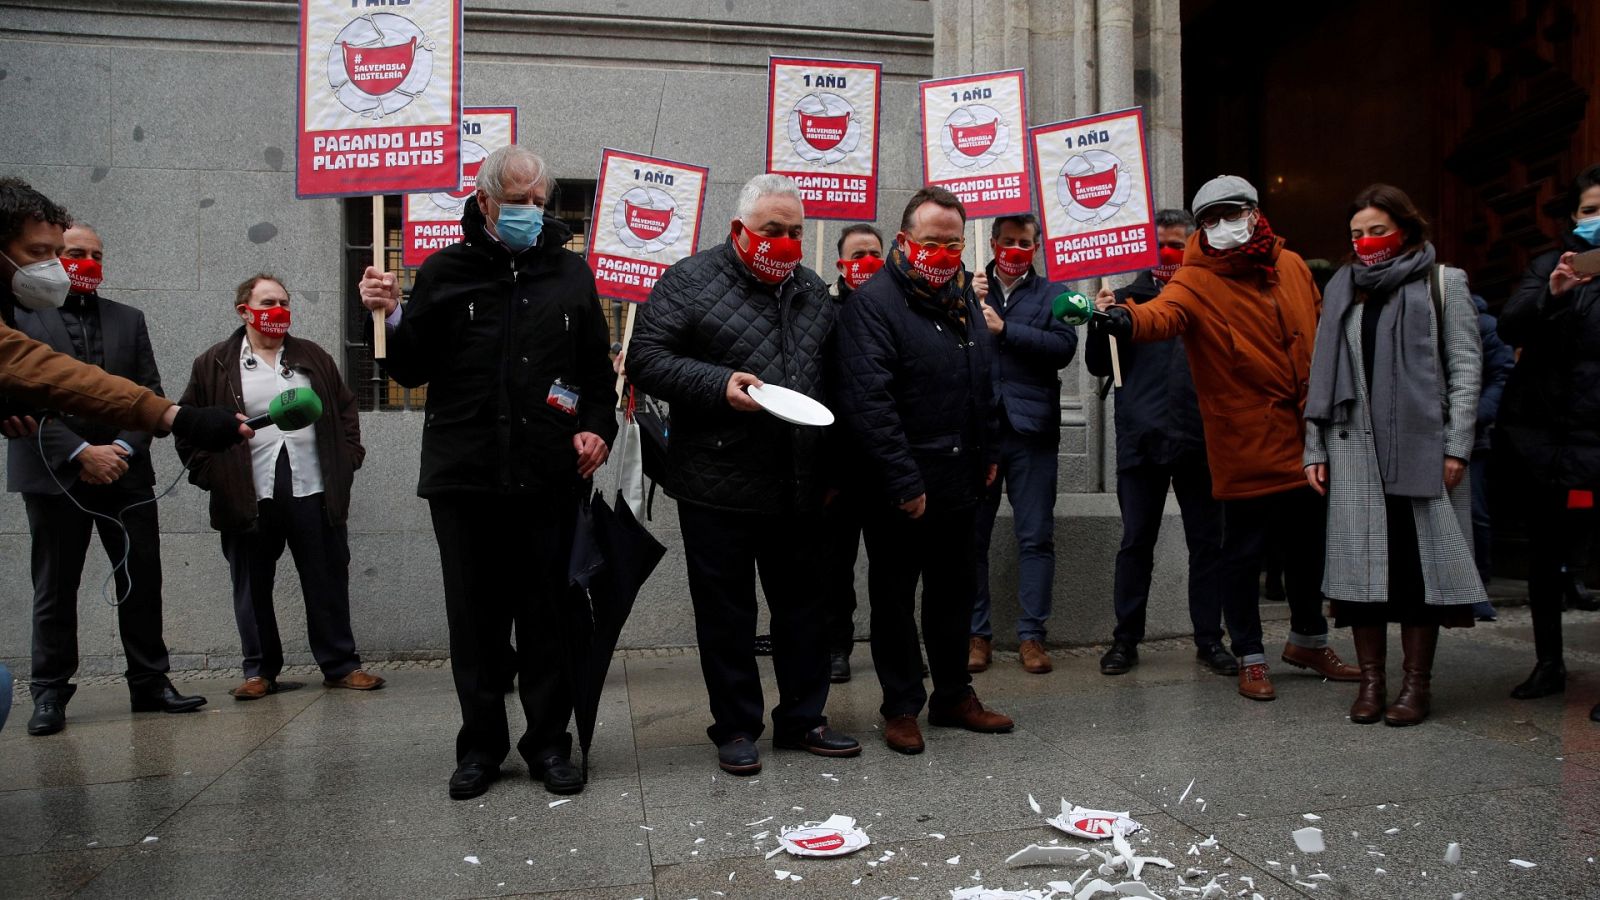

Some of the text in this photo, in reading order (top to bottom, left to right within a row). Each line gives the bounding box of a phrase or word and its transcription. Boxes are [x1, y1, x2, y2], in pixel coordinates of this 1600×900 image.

[354, 54, 362, 64] #
[354, 63, 406, 72] SALVEMOSLA
[354, 70, 403, 80] HOSTELERÍA
[804, 74, 846, 88] 1 AÑO
[952, 88, 992, 102] 1 AÑO
[314, 131, 444, 152] PAGANDO LOS
[1065, 130, 1110, 149] 1 AÑO
[313, 150, 444, 170] PLATOS ROTOS
[634, 169, 674, 186] 1 AÑO
[787, 176, 866, 190] GANDO LOS
[998, 176, 1020, 188] LOS
[826, 190, 866, 203] ROTOS
[982, 188, 1020, 201] ROTOS
[1055, 228, 1146, 252] PAGANDO LOS
[757, 241, 770, 254] #
[1056, 241, 1147, 265] PLATOS ROTOS
[917, 249, 929, 260] #
[68, 263, 78, 272] #
[598, 257, 657, 276] PAGANDO
[851, 263, 859, 272] #
[596, 269, 640, 286] PLATOS
[260, 312, 269, 321] #
